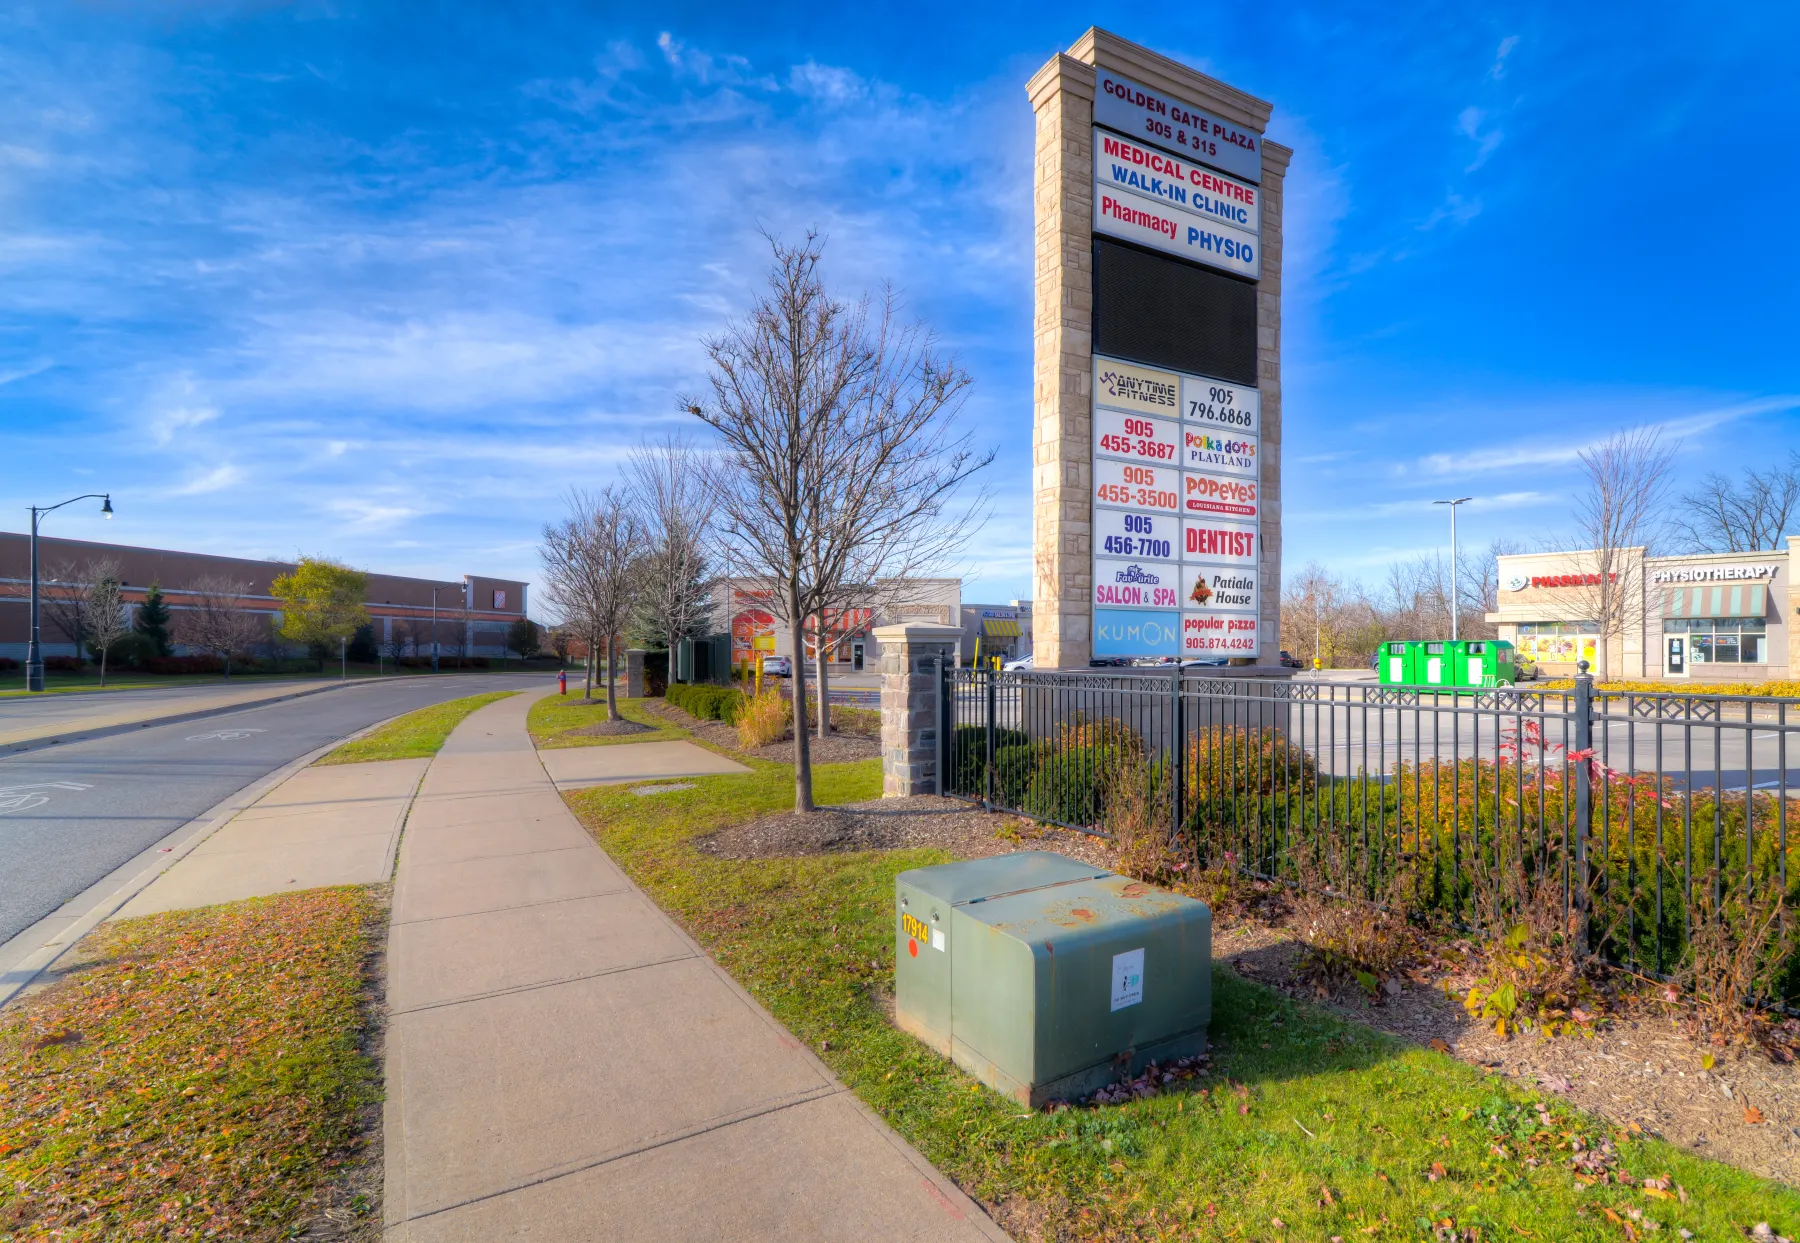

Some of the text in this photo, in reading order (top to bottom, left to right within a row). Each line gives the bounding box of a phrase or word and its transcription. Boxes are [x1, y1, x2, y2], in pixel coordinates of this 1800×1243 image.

[1103, 79, 1255, 152] GOLDEN GATE PLAZA
[1146, 118, 1217, 156] 305 & 315
[1104, 137, 1254, 205] MEDICAL CENTRE
[1111, 164, 1248, 224] WALK-IN CLINIC
[1102, 196, 1253, 263] Pharmacy PHYSIO
[1117, 375, 1176, 397] ANYTIME
[1209, 387, 1233, 405] 905
[1118, 388, 1175, 407] FITNESS
[1189, 401, 1252, 426] 796.6868
[1124, 418, 1153, 438] 905
[1100, 434, 1175, 460] 455-3687
[1224, 440, 1255, 457] dots
[1191, 450, 1252, 468] PLAYLAND
[1123, 466, 1154, 486] 905
[1097, 484, 1177, 509] 455-3500
[1192, 501, 1250, 513] LOUISIANA KITCHEN
[1124, 514, 1153, 534] 905
[1104, 535, 1171, 558] 456-7700
[1186, 527, 1254, 557] DENTIST
[1213, 575, 1253, 590] Patiala
[1652, 565, 1777, 583] PHYSIOTHERAPY
[1097, 585, 1176, 606] SALON & SPA
[1215, 591, 1251, 605] House
[1098, 622, 1176, 645] KUMON
[1184, 616, 1255, 634] popular pizza
[1186, 637, 1254, 650] 905.874.4242
[903, 913, 928, 944] 17914
